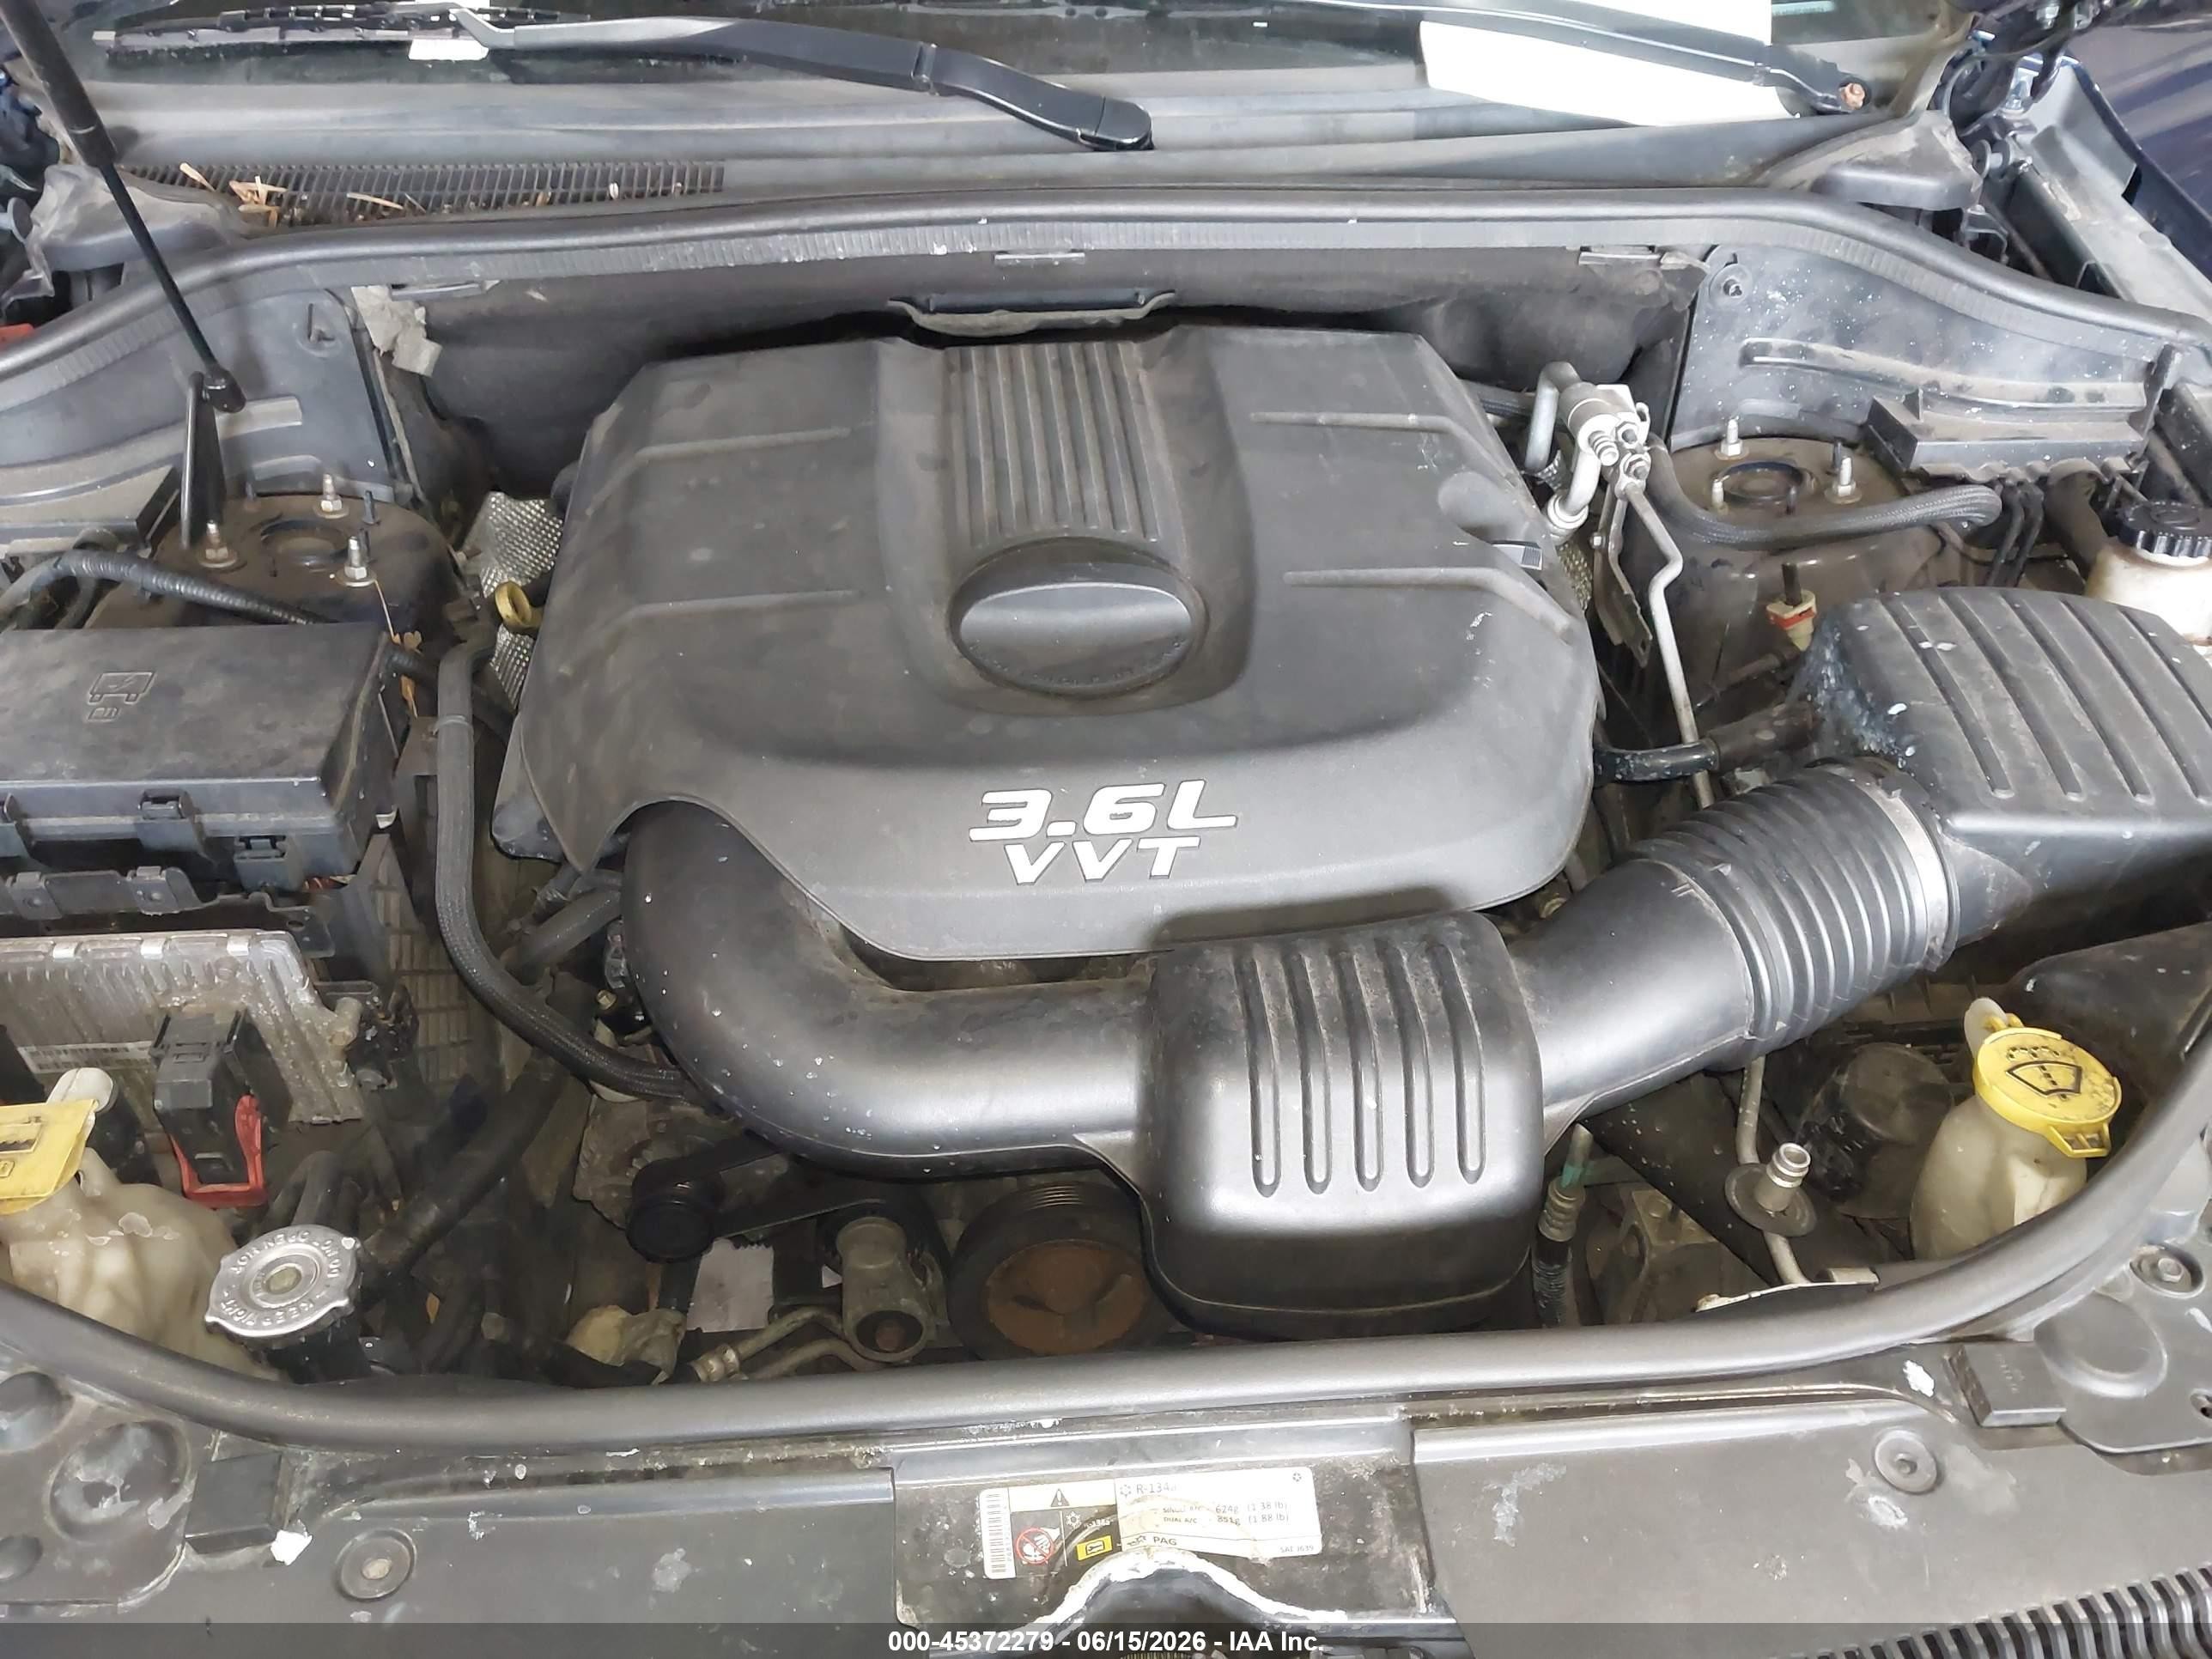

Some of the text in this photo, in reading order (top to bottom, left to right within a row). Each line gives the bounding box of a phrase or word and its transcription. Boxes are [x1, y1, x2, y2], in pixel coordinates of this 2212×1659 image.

[969, 779, 1239, 842] 3.6L
[1004, 836, 1201, 886] VVT
[263, 1230, 311, 1250] OPEN
[219, 1298, 315, 1327] KEEP TIGHT
[1153, 1536, 1177, 1546] PAG
